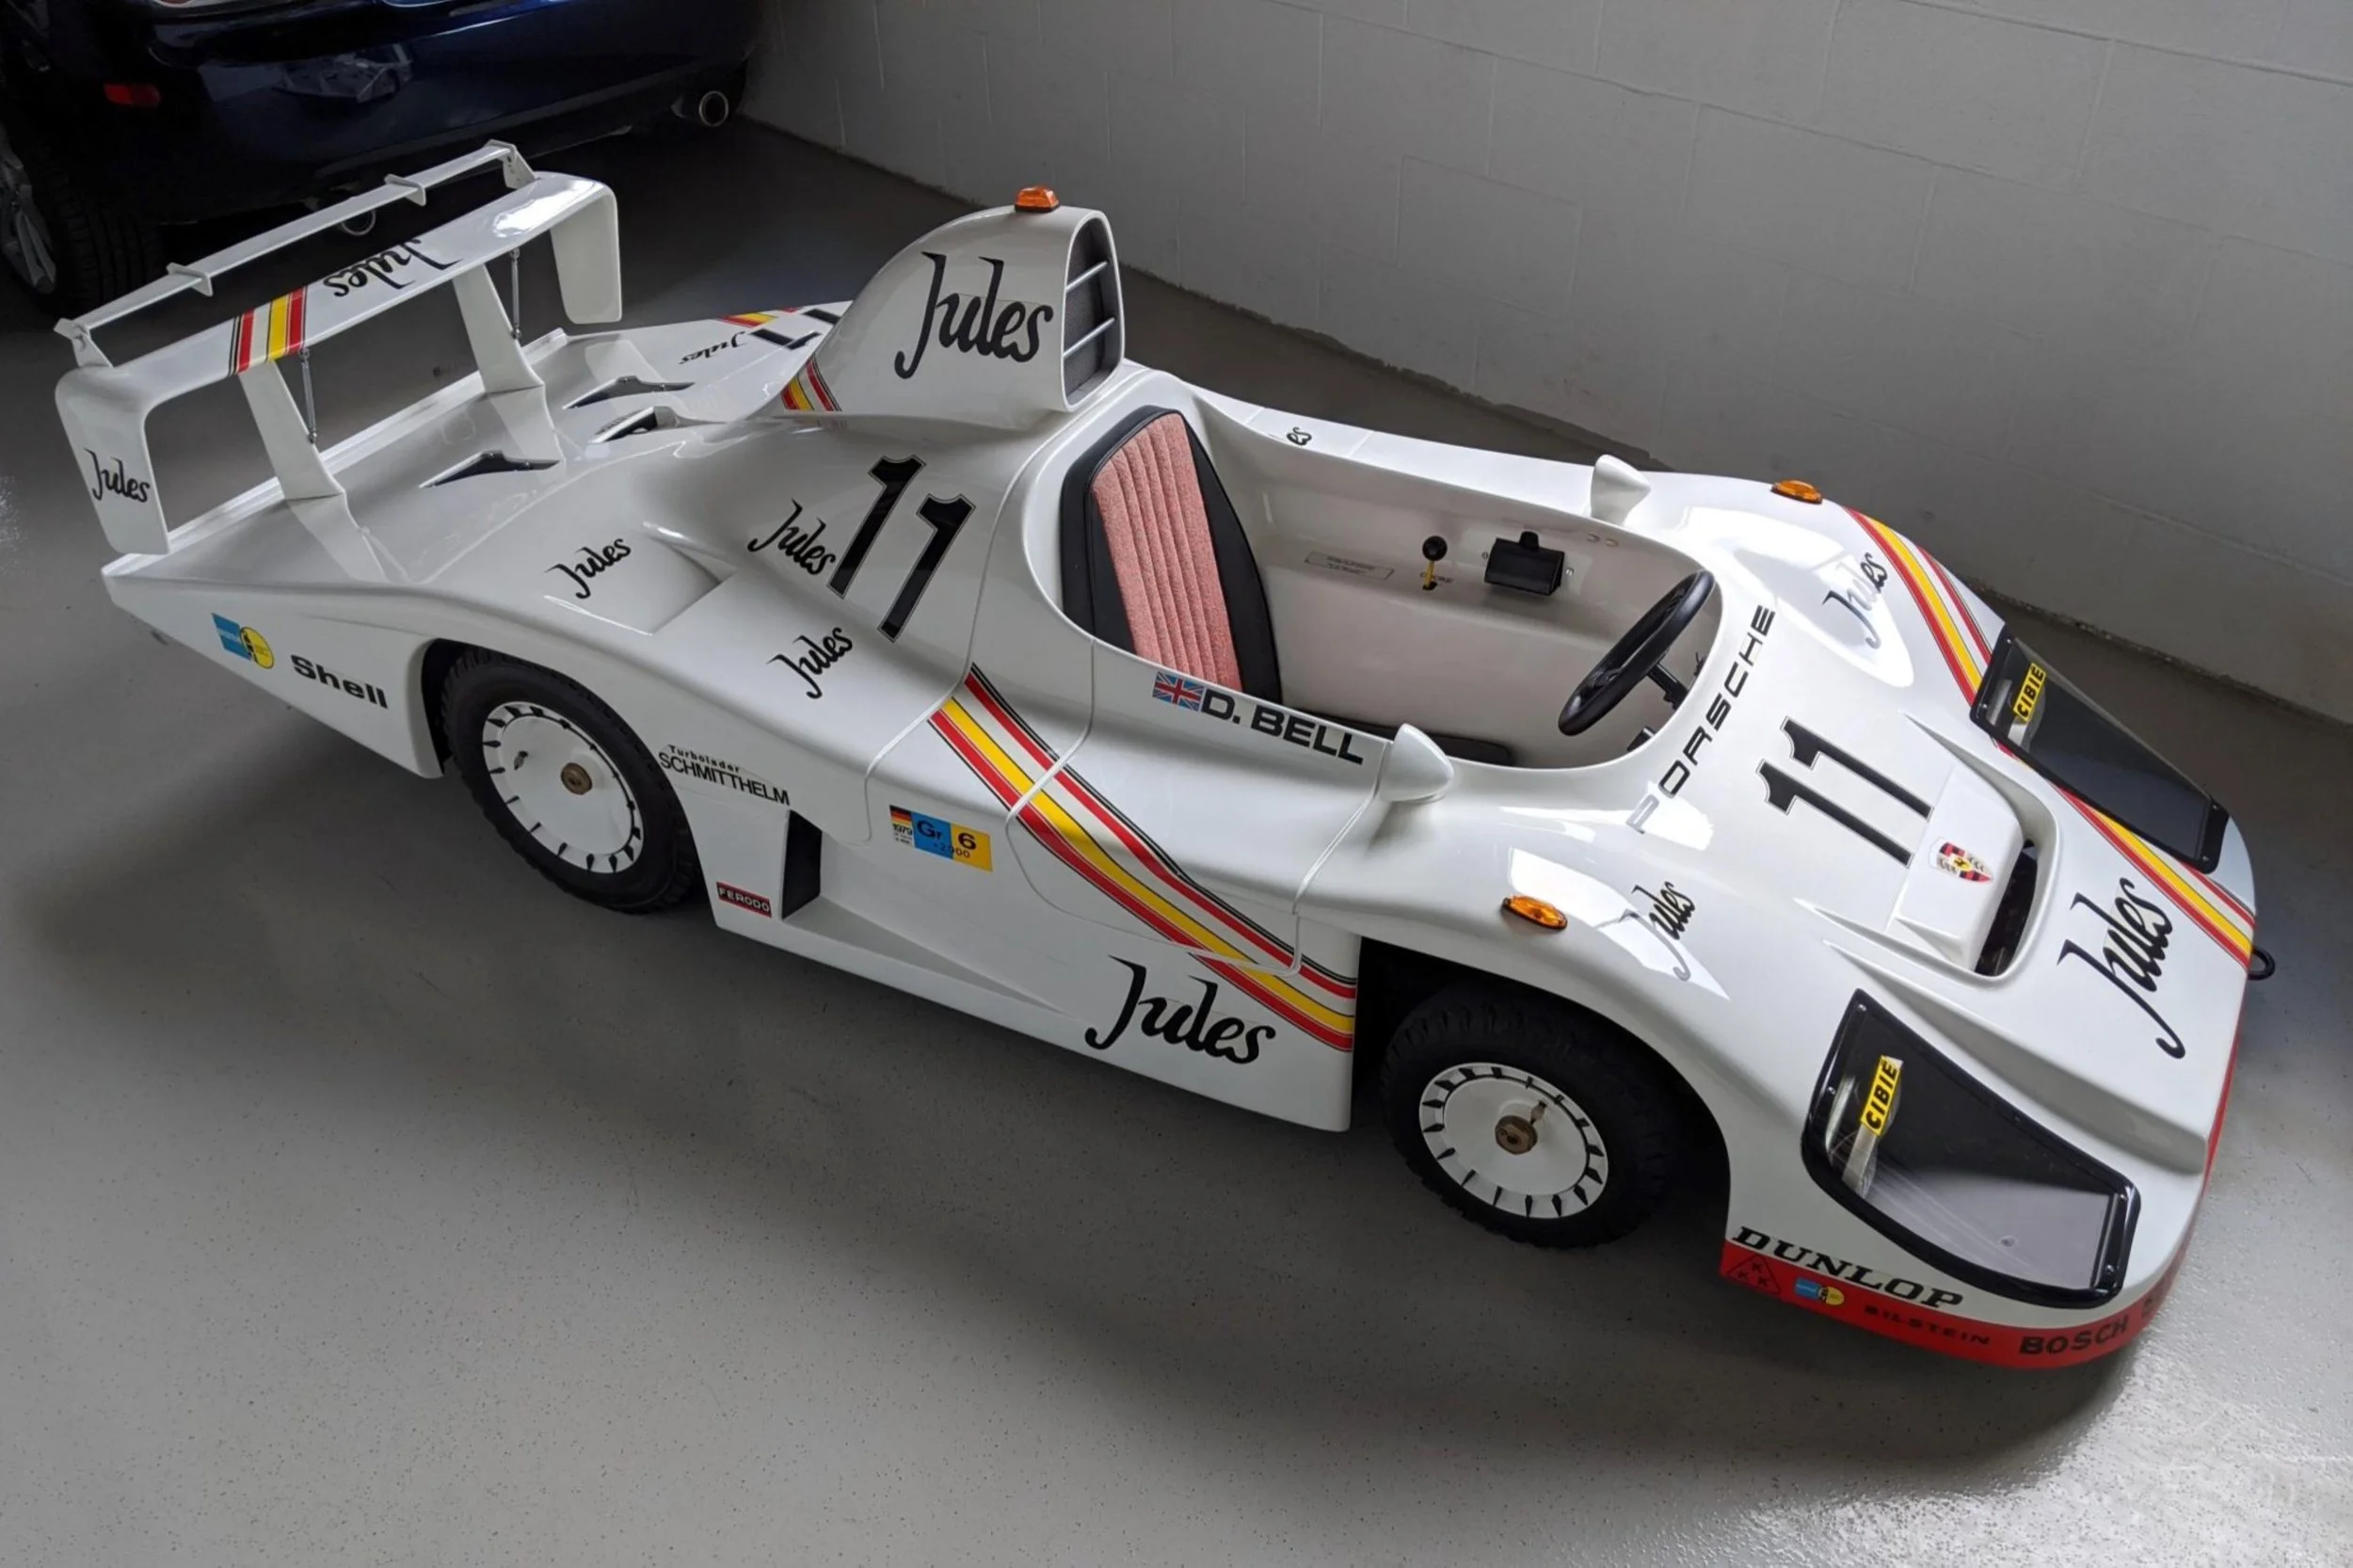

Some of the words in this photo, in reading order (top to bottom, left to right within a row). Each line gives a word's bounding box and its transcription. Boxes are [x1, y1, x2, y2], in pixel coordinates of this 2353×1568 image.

[323, 238, 464, 297] Jules
[678, 330, 749, 365] Jules
[894, 250, 1054, 380] Jules
[83, 447, 152, 504] Jules
[544, 537, 632, 600] Jules
[746, 498, 837, 577] Jules
[827, 454, 976, 643] 11
[1821, 552, 1888, 649] Jules
[290, 654, 389, 709] Shell
[766, 625, 854, 699] Jules
[1200, 688, 1241, 724] D.
[1251, 704, 1364, 765] BELL
[1625, 604, 1775, 834] PORSCHE
[659, 752, 791, 806] SCHMITTHELM
[668, 744, 740, 773] Turbolader
[1756, 716, 1935, 868] 11
[958, 832, 977, 851] 6
[718, 887, 771, 912] FERODO
[1619, 881, 1696, 982] Jules
[2057, 876, 2186, 1060] Jules
[1085, 954, 1276, 1065] Jules
[1732, 1225, 1964, 1309] DUNLOP
[1865, 1304, 1991, 1346] BILSTEIN
[2019, 1315, 2129, 1355] BOSCH
